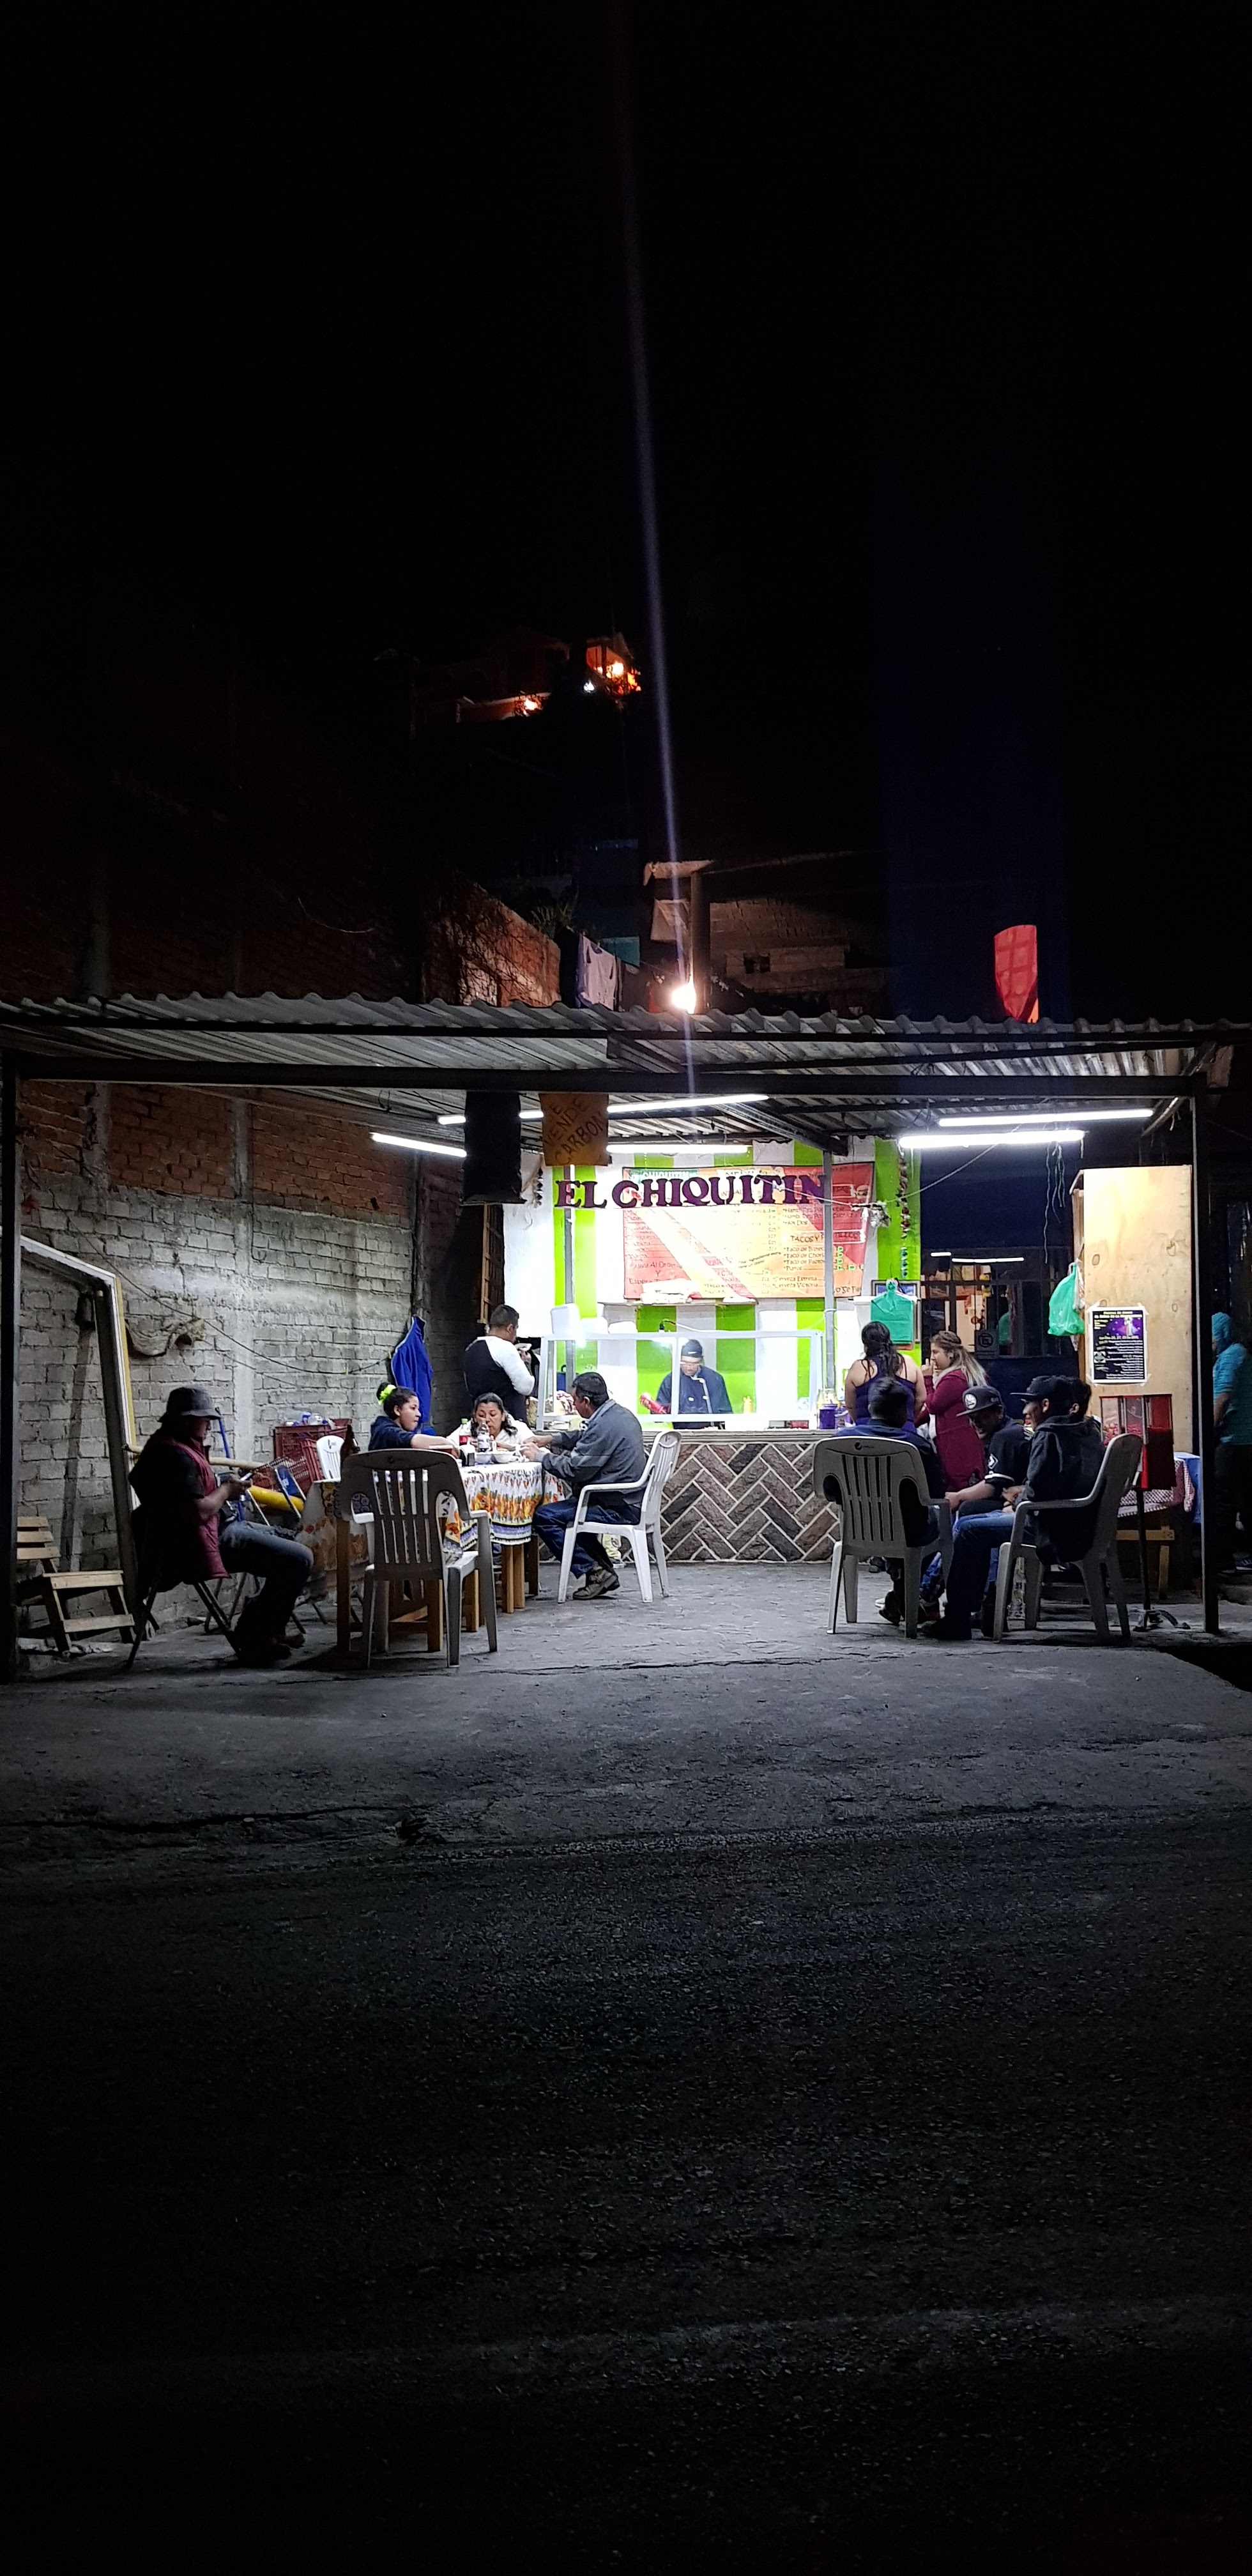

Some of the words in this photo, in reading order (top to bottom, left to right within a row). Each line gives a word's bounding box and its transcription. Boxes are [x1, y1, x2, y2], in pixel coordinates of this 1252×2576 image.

[554, 1111, 604, 1164] CARBON
[555, 1179, 607, 1208] EL
[611, 1174, 828, 1208] CHIQUITIN
[790, 1235, 814, 1243] TACOS
